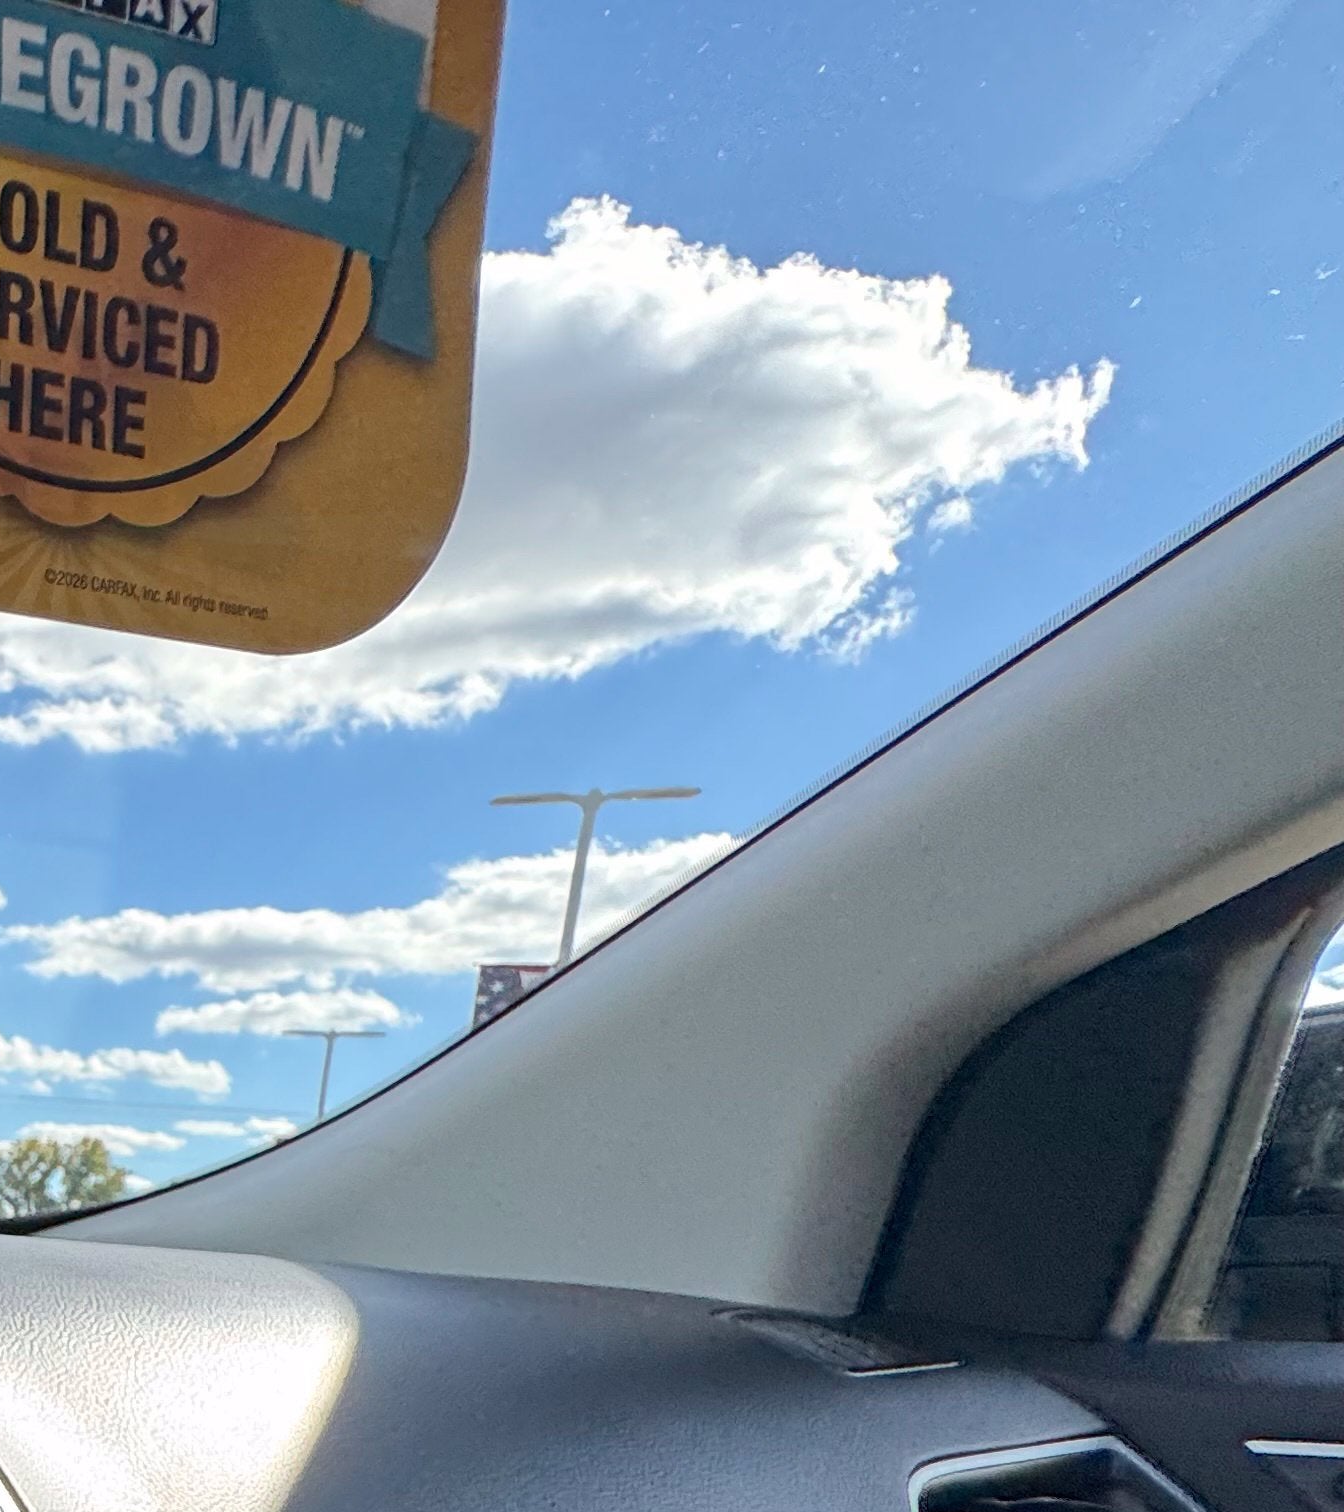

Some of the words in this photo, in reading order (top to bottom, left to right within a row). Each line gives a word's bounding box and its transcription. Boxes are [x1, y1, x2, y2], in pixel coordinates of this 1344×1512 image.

[141, 216, 187, 291] &
[91, 574, 141, 601] CARFAX,
[165, 589, 181, 606] All
[182, 593, 216, 613] rights
